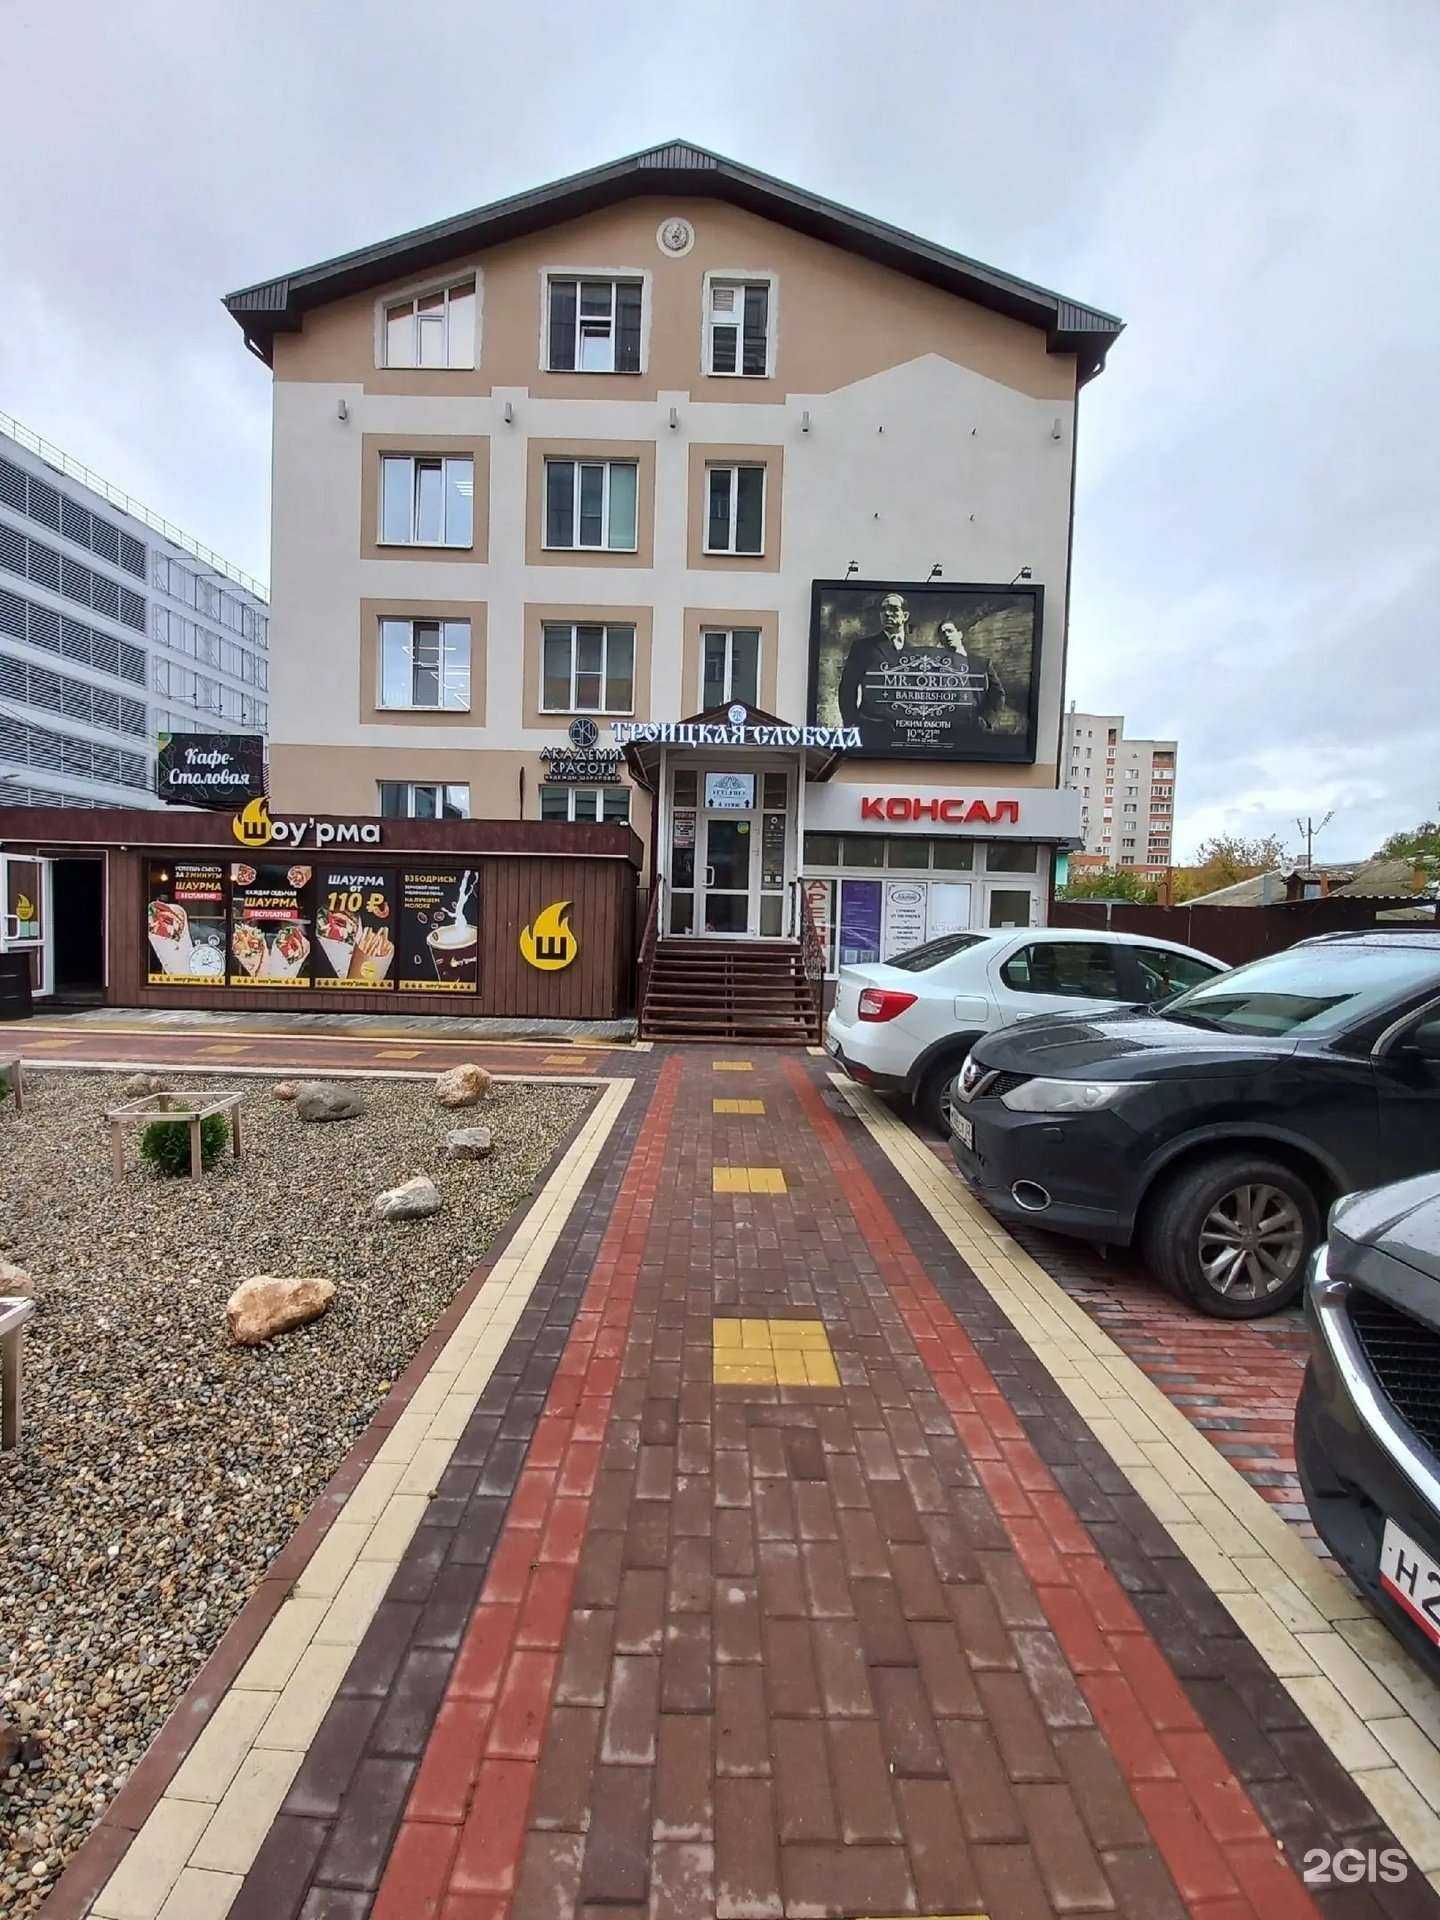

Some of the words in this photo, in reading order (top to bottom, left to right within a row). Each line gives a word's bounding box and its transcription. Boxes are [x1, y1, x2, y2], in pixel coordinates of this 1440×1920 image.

[884, 675, 912, 687] MR.
[916, 675, 970, 688] ORLOV
[895, 691, 957, 701] BARBERSHOP
[896, 720, 922, 729] РЕЖИМ
[611, 722, 746, 748] ТРОИЦКАЯ
[753, 725, 863, 750] СЛОБОДА
[185, 748, 234, 768] Кафе-
[550, 762, 616, 774] КРАСОТЫ
[169, 768, 250, 785] Столовая
[861, 797, 1019, 824] КОНСАЛ
[328, 875, 384, 886] ШАУРМА
[404, 875, 457, 883] ВЗБОДРИСЬ!
[175, 882, 222, 891] ШАУРМА
[244, 897, 298, 908] ШАУРМА
[328, 892, 363, 912] 110
